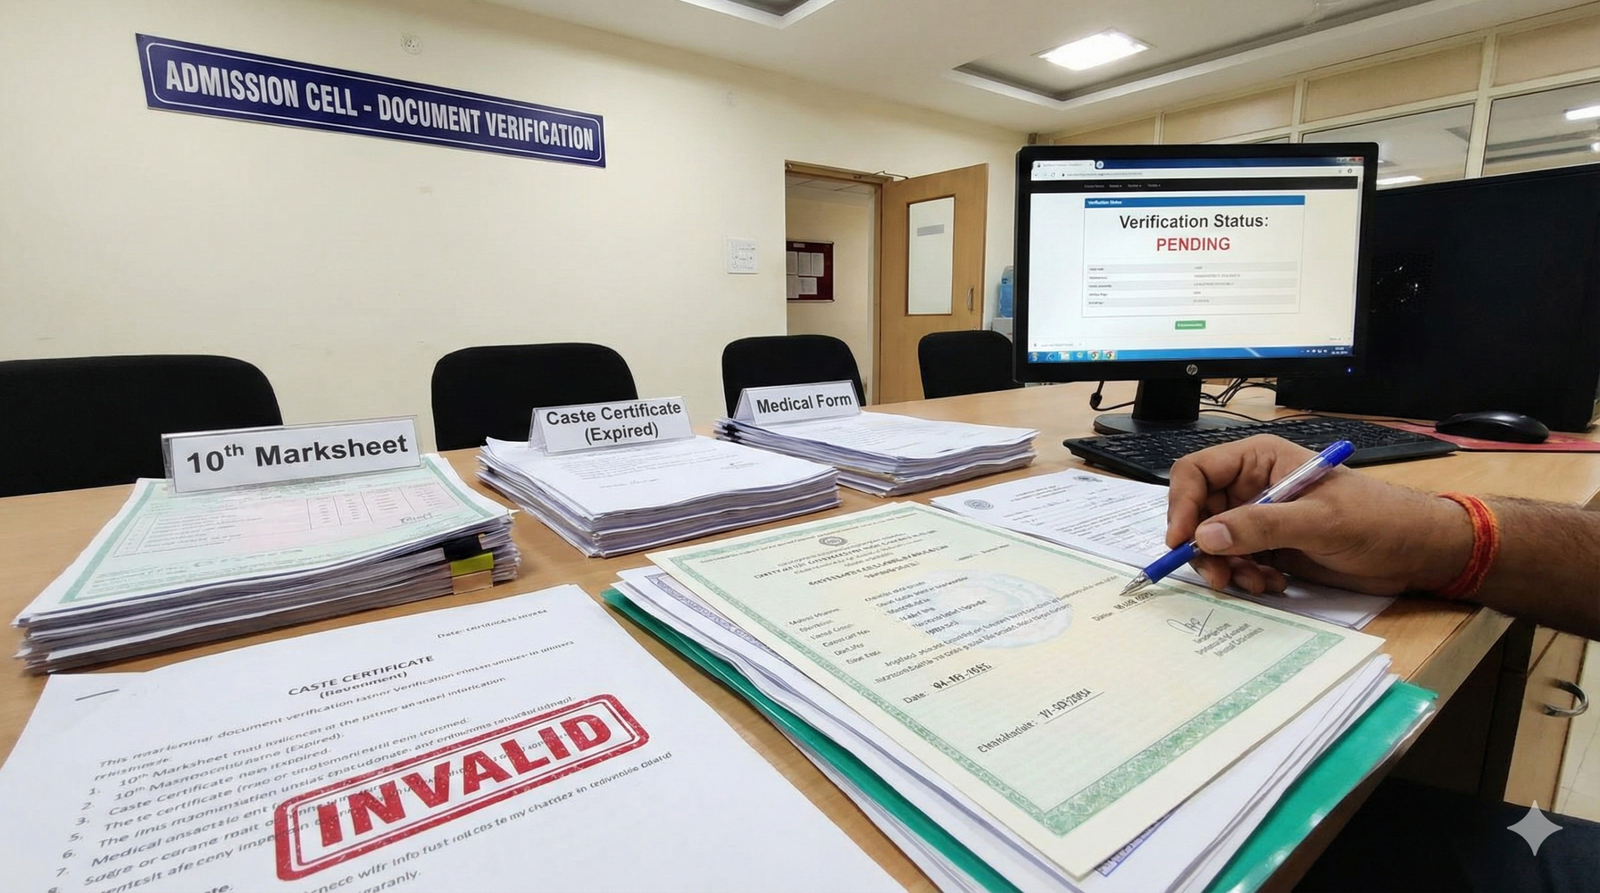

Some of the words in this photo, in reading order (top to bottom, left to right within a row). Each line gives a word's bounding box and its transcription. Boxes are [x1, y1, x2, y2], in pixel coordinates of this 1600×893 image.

[166, 60, 299, 108] ADMISSION
[305, 82, 358, 117] CELL
[377, 94, 480, 134] DOCUMENT
[485, 111, 594, 152] VERIFICATION
[1119, 213, 1208, 229] Verification
[1214, 213, 1269, 228] Status:
[1156, 237, 1231, 252] PENDING
[546, 408, 596, 426] Caste
[600, 401, 682, 422] Certificate
[757, 395, 813, 414] Medical
[817, 393, 852, 409] Form
[585, 421, 659, 445] (Expired)
[187, 443, 244, 474] 10th
[256, 434, 408, 467] Marksheet
[288, 678, 339, 696] CASTE
[342, 654, 435, 683] CERTIFICATE
[99, 756, 129, 768] This
[217, 717, 283, 739] document
[286, 699, 354, 721] verification
[393, 672, 455, 693] Verification
[119, 773, 149, 787] 10th
[153, 752, 229, 779] Marksheet
[340, 716, 360, 728] the
[109, 799, 153, 816] Caste
[156, 775, 234, 802] Certificate
[316, 713, 613, 849] INVALID
[156, 788, 233, 817] certificate
[509, 808, 526, 821] my
[90, 837, 162, 867] Medical
[99, 833, 130, 848] The
